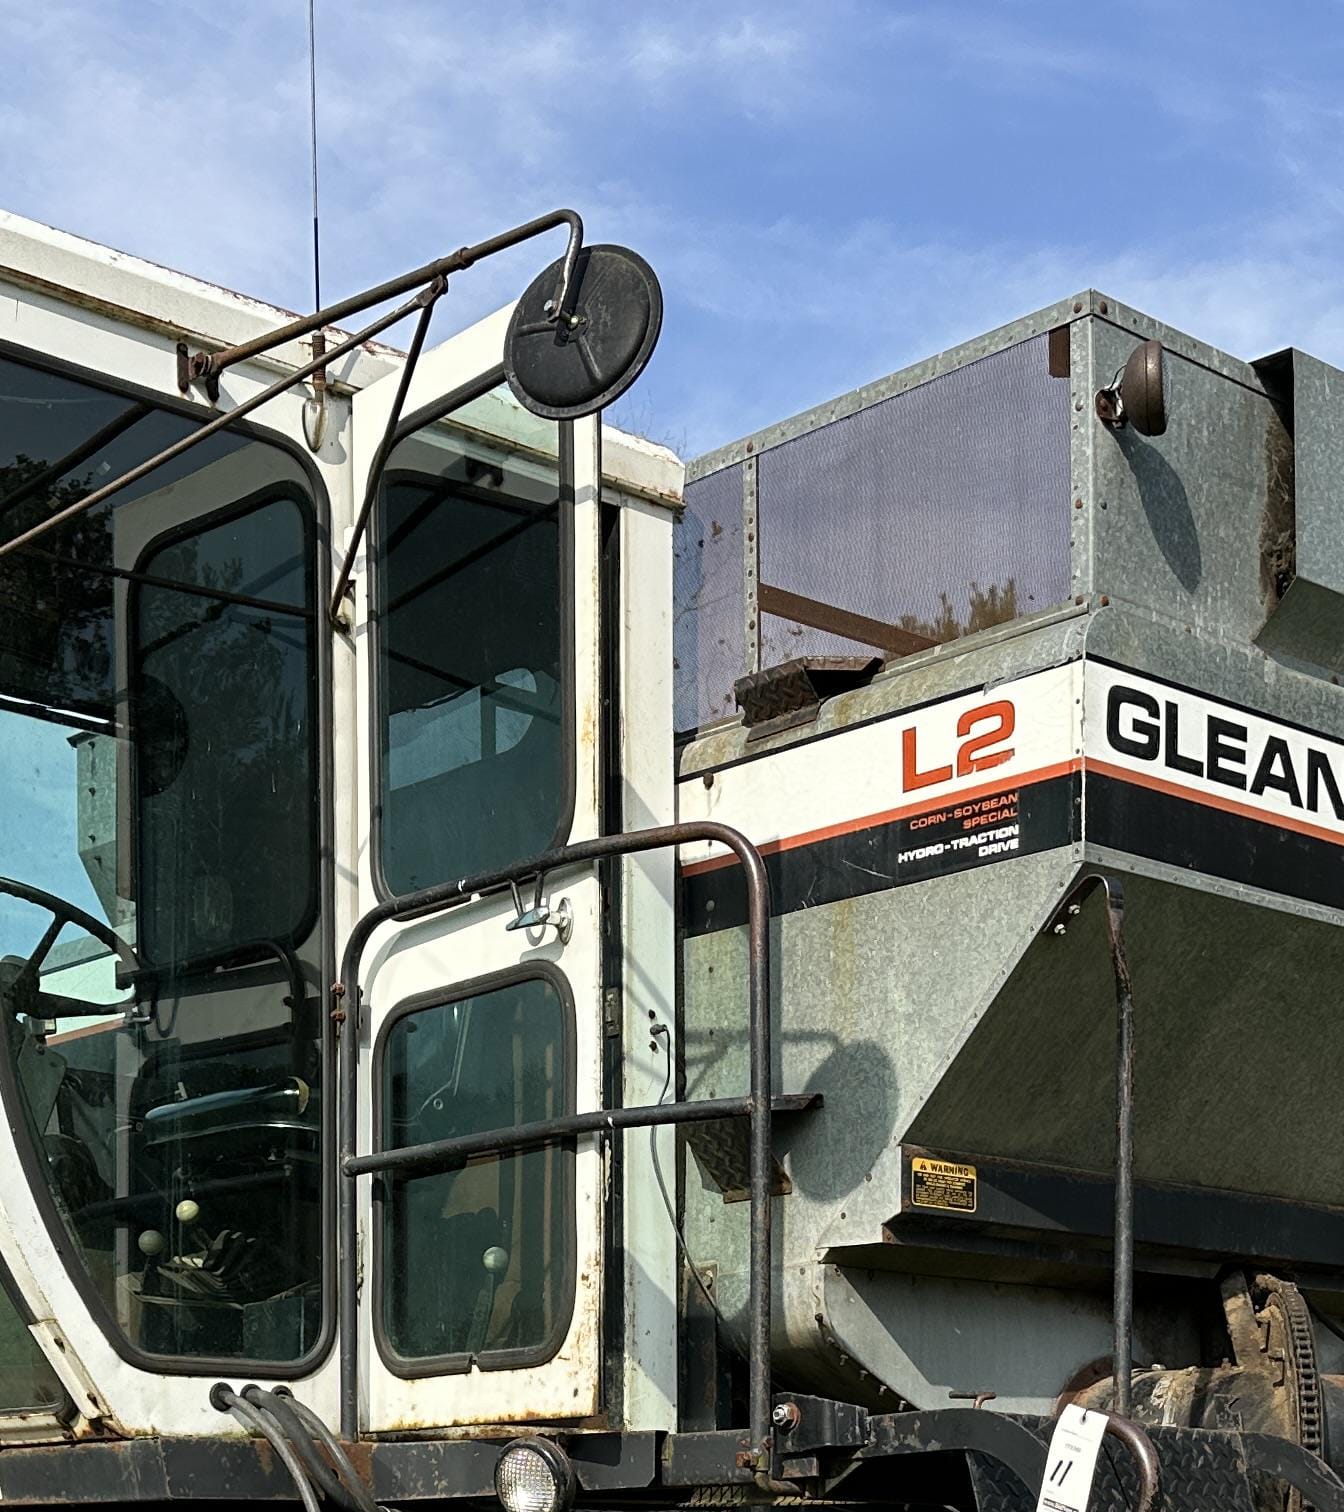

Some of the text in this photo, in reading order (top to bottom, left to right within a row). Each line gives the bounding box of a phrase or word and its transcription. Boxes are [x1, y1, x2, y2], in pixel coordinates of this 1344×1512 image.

[902, 699, 1016, 793] L2
[909, 792, 1019, 831] CORN-SOYBEAN
[962, 809, 1018, 830] SPECIAL
[978, 838, 1019, 858] DRIVE
[930, 1162, 969, 1177] WARNING
